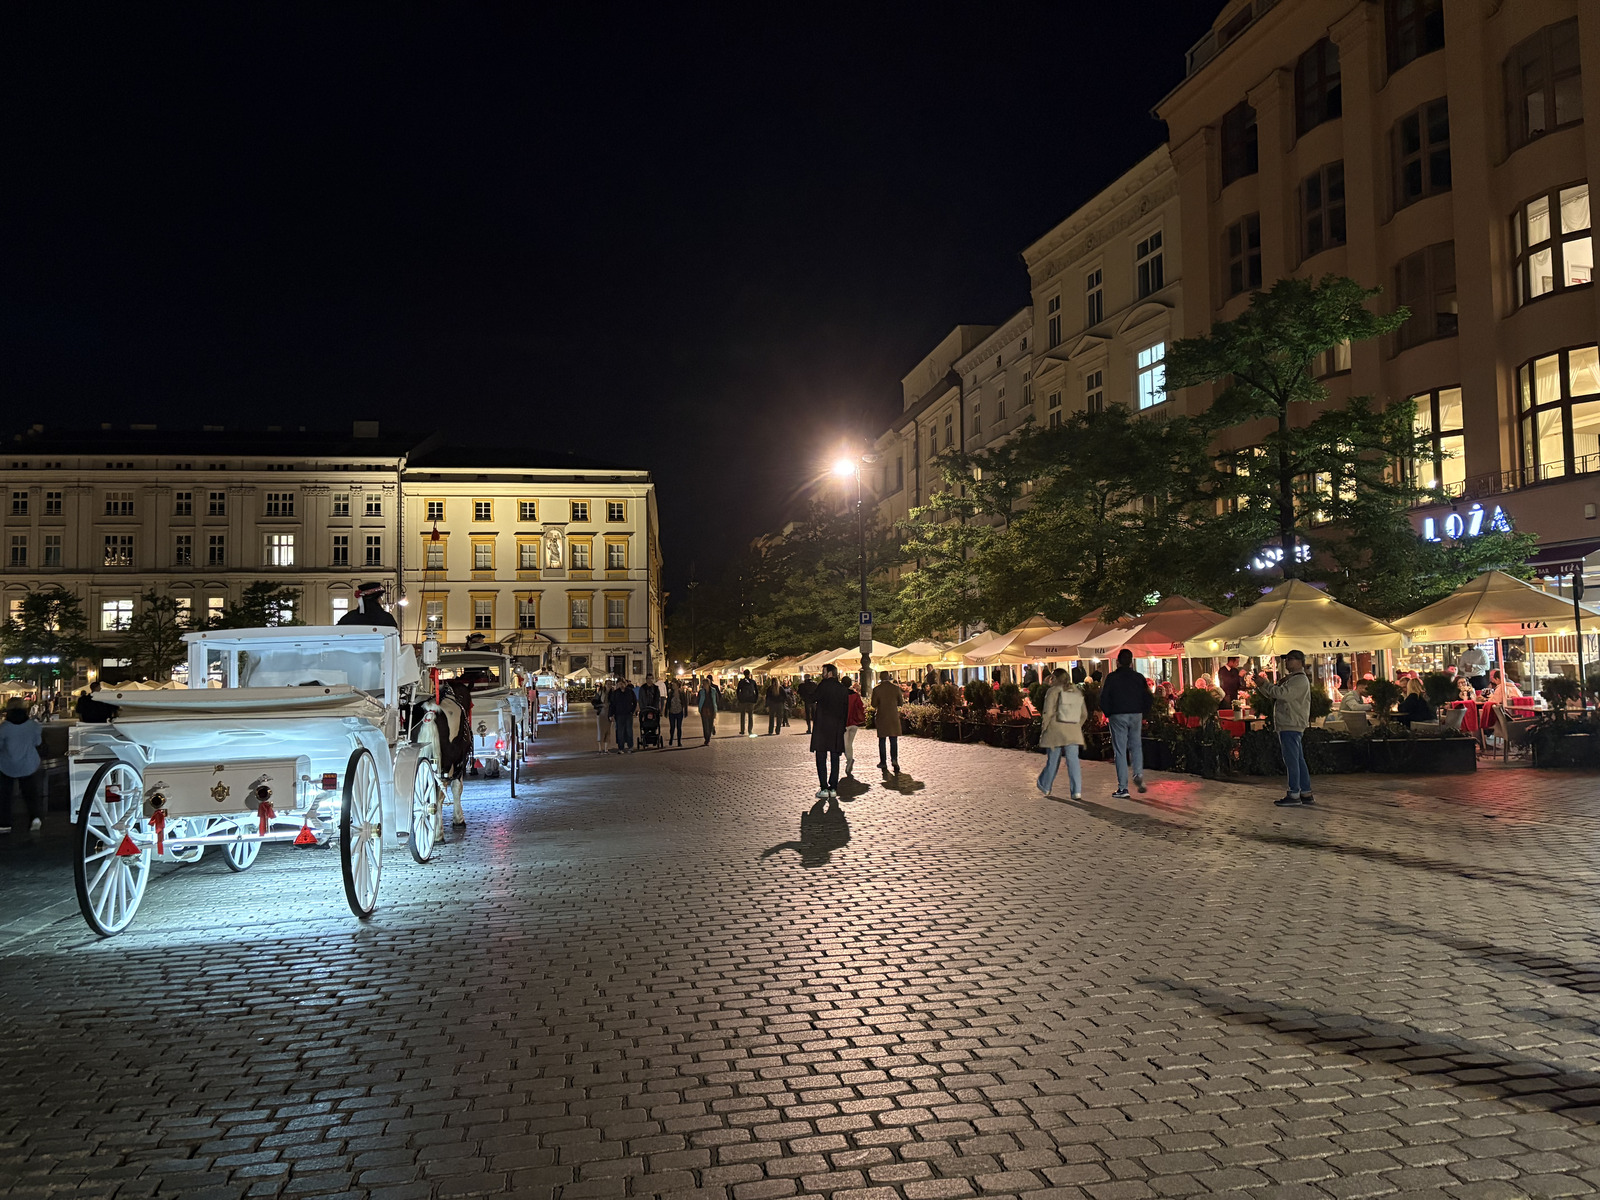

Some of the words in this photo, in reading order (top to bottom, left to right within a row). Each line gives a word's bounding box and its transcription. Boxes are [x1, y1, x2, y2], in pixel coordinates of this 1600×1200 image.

[1425, 503, 1511, 542] LOŻA
[1560, 563, 1580, 573] LOŻA
[862, 613, 870, 623] P
[1521, 620, 1548, 630] LOŻA
[1322, 638, 1349, 648] LOŻA
